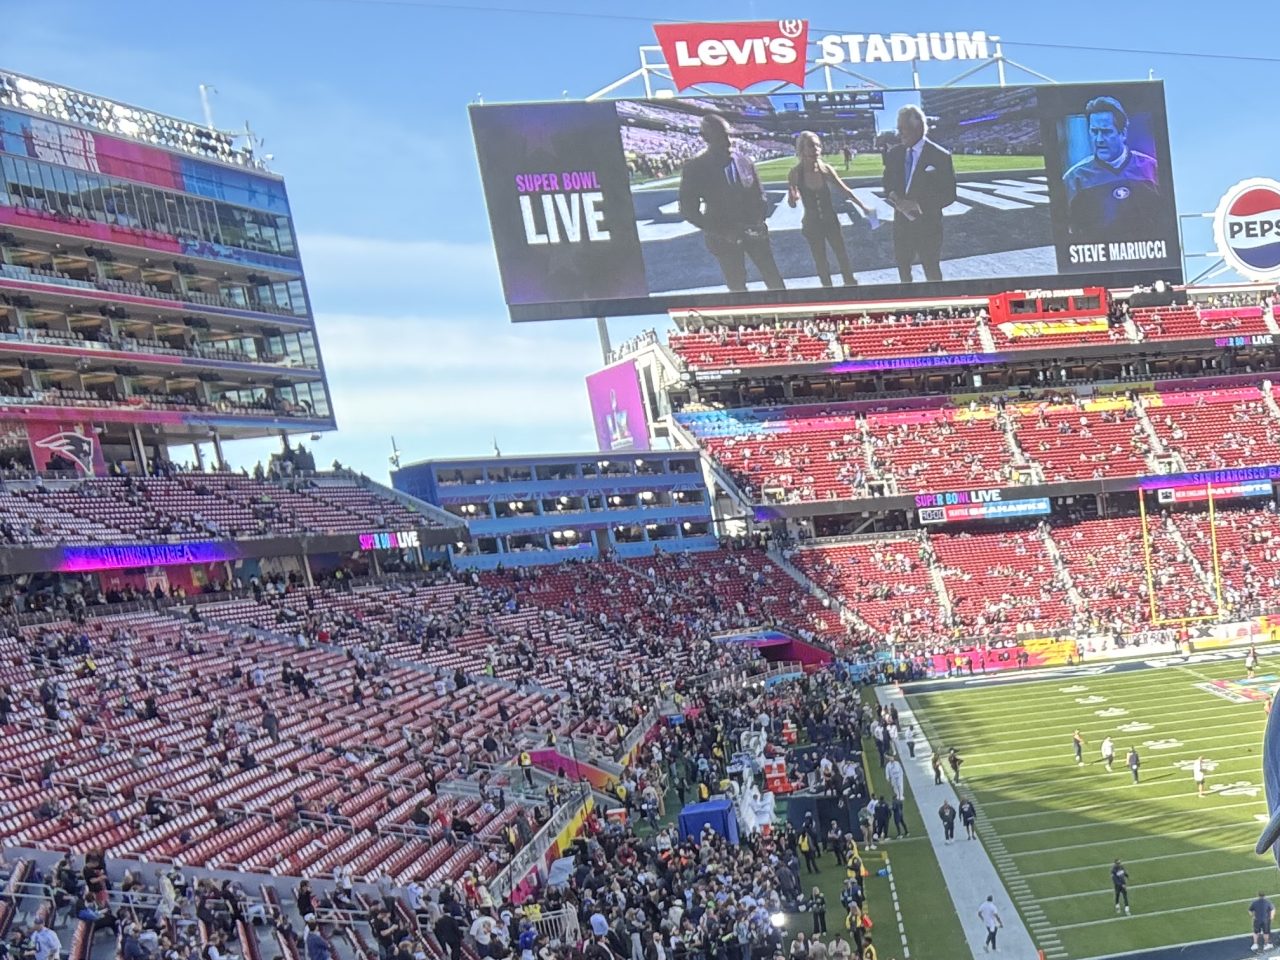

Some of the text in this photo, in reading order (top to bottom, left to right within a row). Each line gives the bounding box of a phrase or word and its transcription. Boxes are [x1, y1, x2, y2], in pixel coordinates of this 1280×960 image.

[820, 31, 988, 63] STADIUM
[516, 171, 600, 192] SUPER BOWL
[520, 192, 611, 245] LIVE
[1069, 240, 1167, 264] STEVE MARIUCCI
[954, 354, 980, 365] AREA
[1193, 474, 1211, 484] SAN
[1215, 467, 1265, 482] FRANCISCO
[915, 490, 1002, 507] SUPER BOWL LIVE
